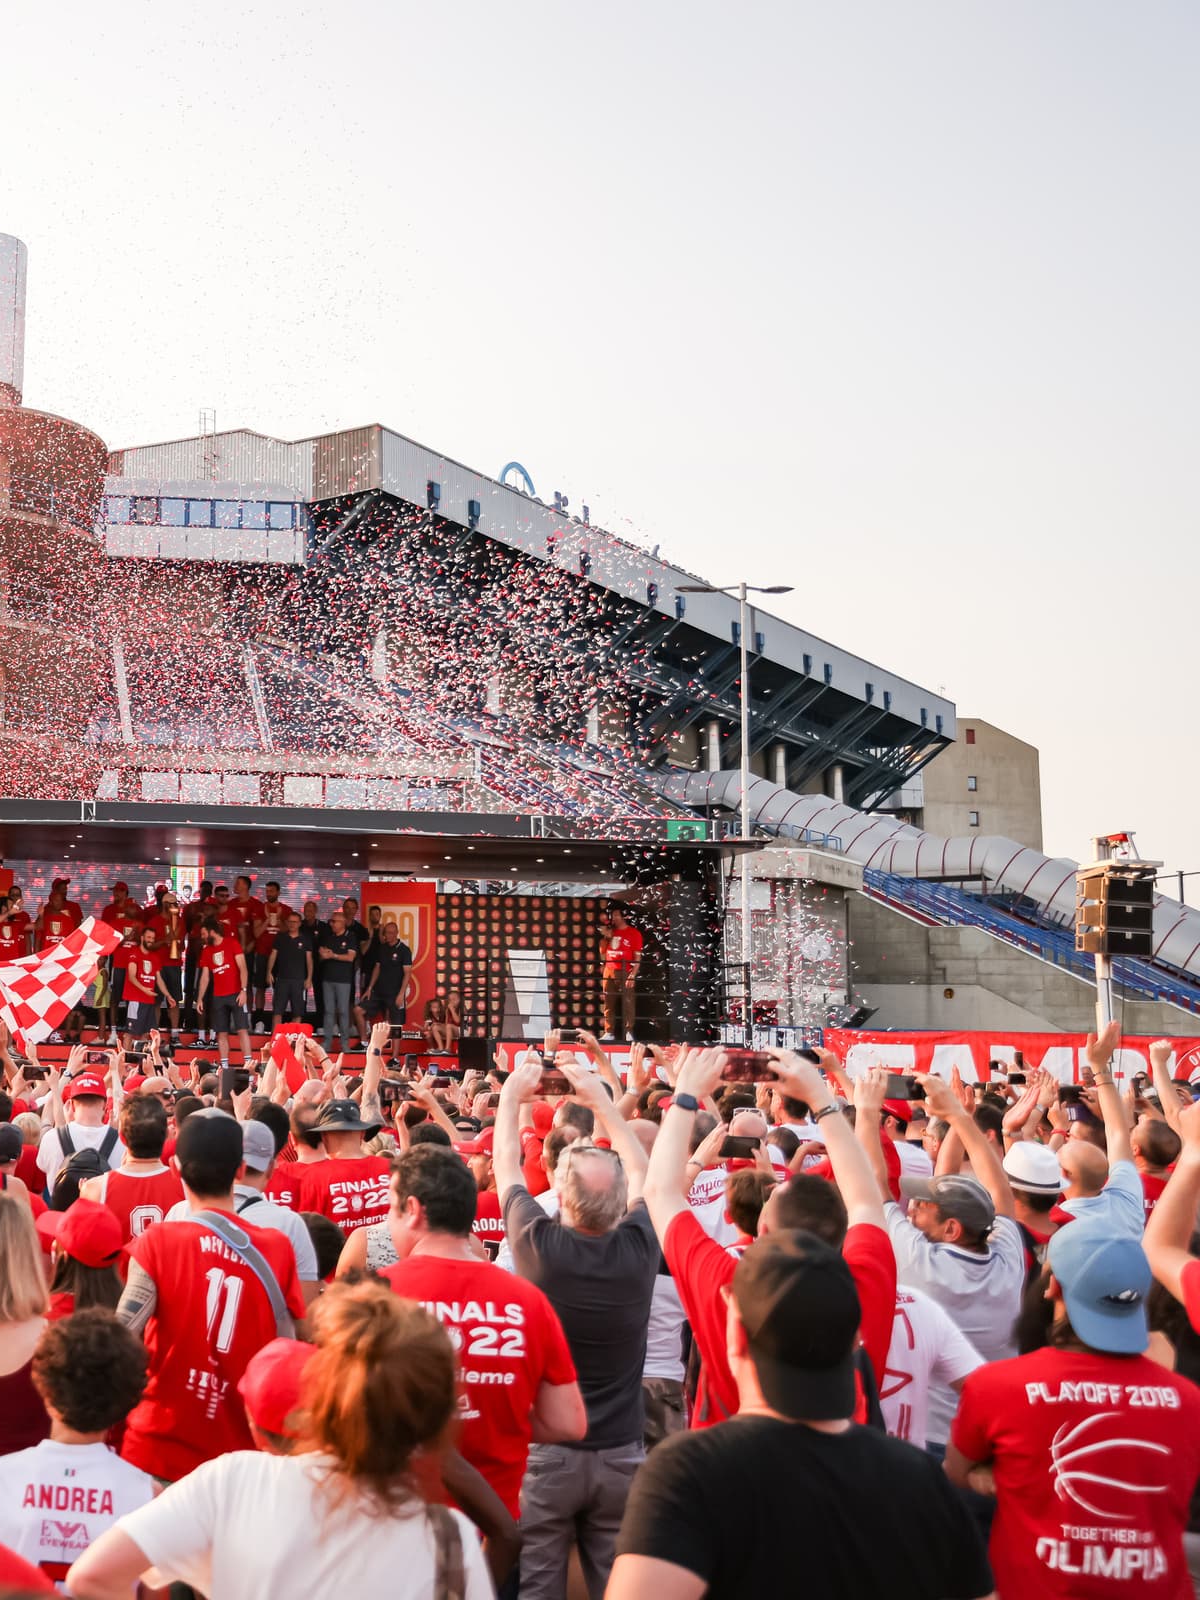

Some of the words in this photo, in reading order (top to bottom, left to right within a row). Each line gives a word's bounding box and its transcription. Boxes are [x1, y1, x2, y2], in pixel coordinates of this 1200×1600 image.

[330, 1174, 390, 1196] FINALS
[205, 1267, 243, 1353] 11
[1025, 1382, 1121, 1405] PLAYOFF
[1125, 1386, 1181, 1408] 2019
[22, 1483, 114, 1515] ANDREA
[1060, 1524, 1136, 1544] TOGETHER
[1036, 1536, 1168, 1580] OLIMPIA
